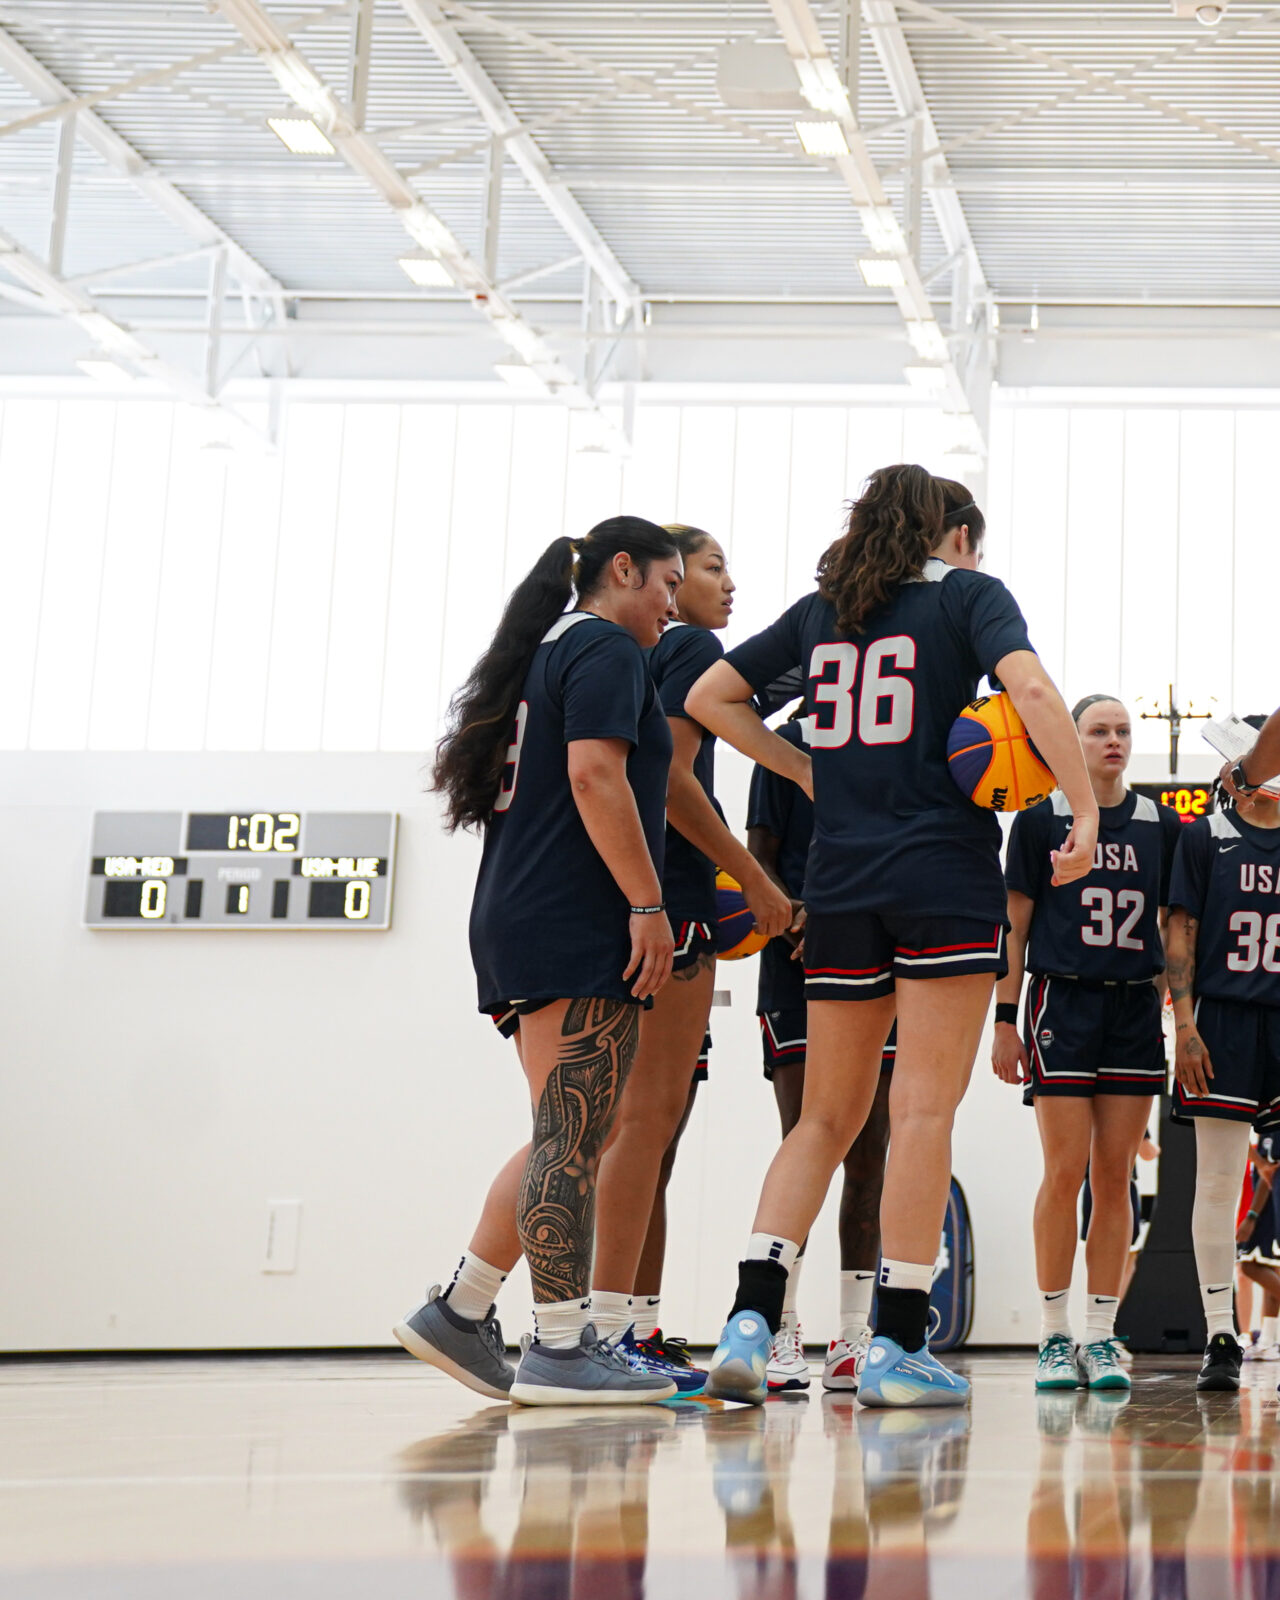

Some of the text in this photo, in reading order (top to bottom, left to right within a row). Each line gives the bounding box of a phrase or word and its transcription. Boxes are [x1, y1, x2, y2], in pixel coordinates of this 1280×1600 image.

[808, 634, 917, 749] 36
[228, 813, 299, 852] 1:02
[105, 857, 174, 876] USA-RED
[302, 857, 379, 877] USA-BLUE
[140, 880, 167, 919] 0
[238, 886, 249, 913] 1
[344, 880, 370, 919] 0
[1081, 887, 1145, 950] 32
